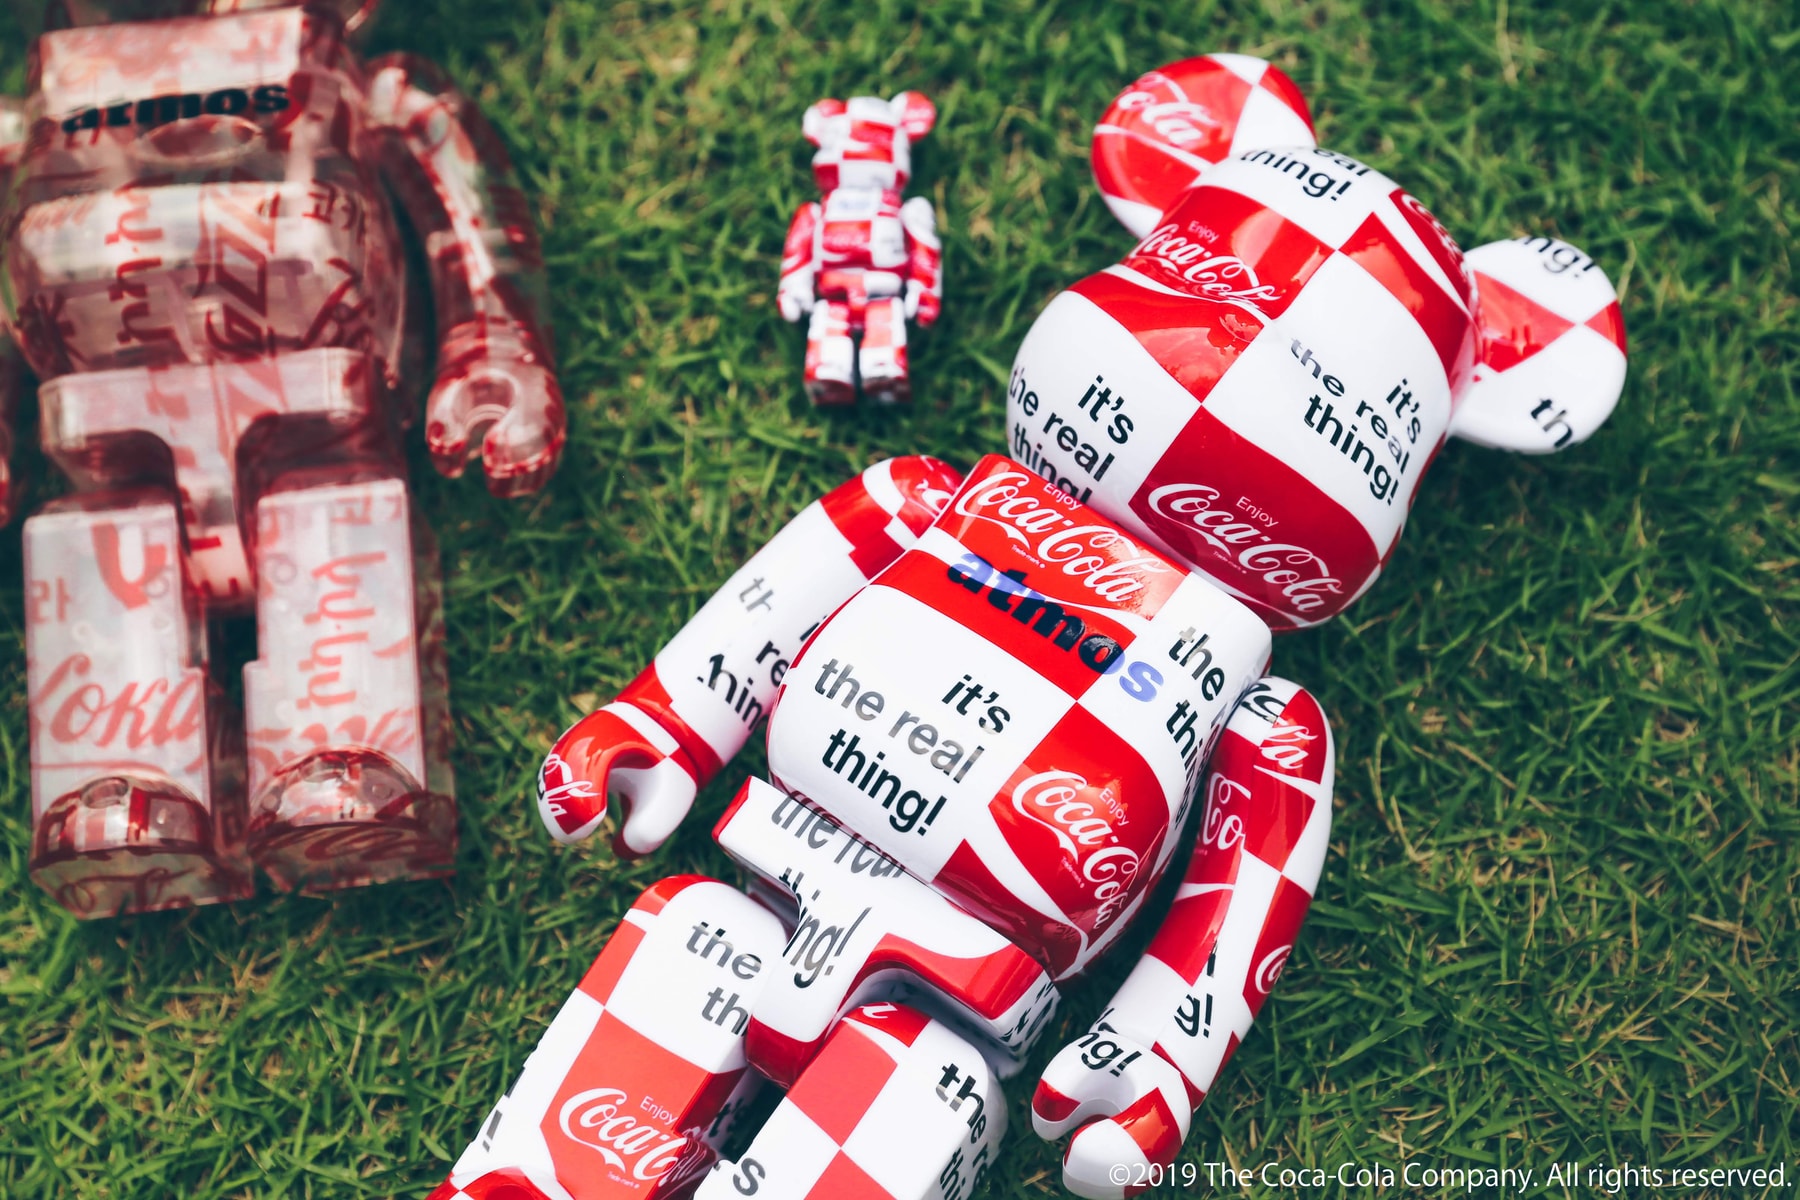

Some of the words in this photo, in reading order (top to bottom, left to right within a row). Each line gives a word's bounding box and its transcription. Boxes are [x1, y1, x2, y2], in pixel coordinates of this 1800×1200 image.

[62, 85, 289, 132] atmos
[1187, 220, 1219, 244] Enjoy
[1009, 366, 1039, 417] the
[1042, 412, 1116, 483] real
[1077, 374, 1134, 445] it's
[1290, 338, 1345, 398] the
[1355, 400, 1410, 475] real
[1386, 378, 1422, 445] it's
[1303, 394, 1400, 507] thing!
[1043, 482, 1083, 511] Enjoy
[1236, 496, 1279, 528] Enjoy
[954, 471, 1170, 603] Coca-Cola
[1148, 483, 1344, 613] Coca-Cola
[946, 552, 1165, 703] atmos
[1168, 626, 1225, 701] the
[814, 658, 885, 721] the
[888, 710, 985, 784] real
[941, 674, 1011, 735] it's
[822, 728, 947, 836] thing!
[1099, 787, 1130, 827] Enjoy
[1012, 770, 1140, 930] Coca-Cola
[685, 921, 763, 980] the
[640, 1095, 678, 1126] Enjoy
[935, 1063, 987, 1143] the
